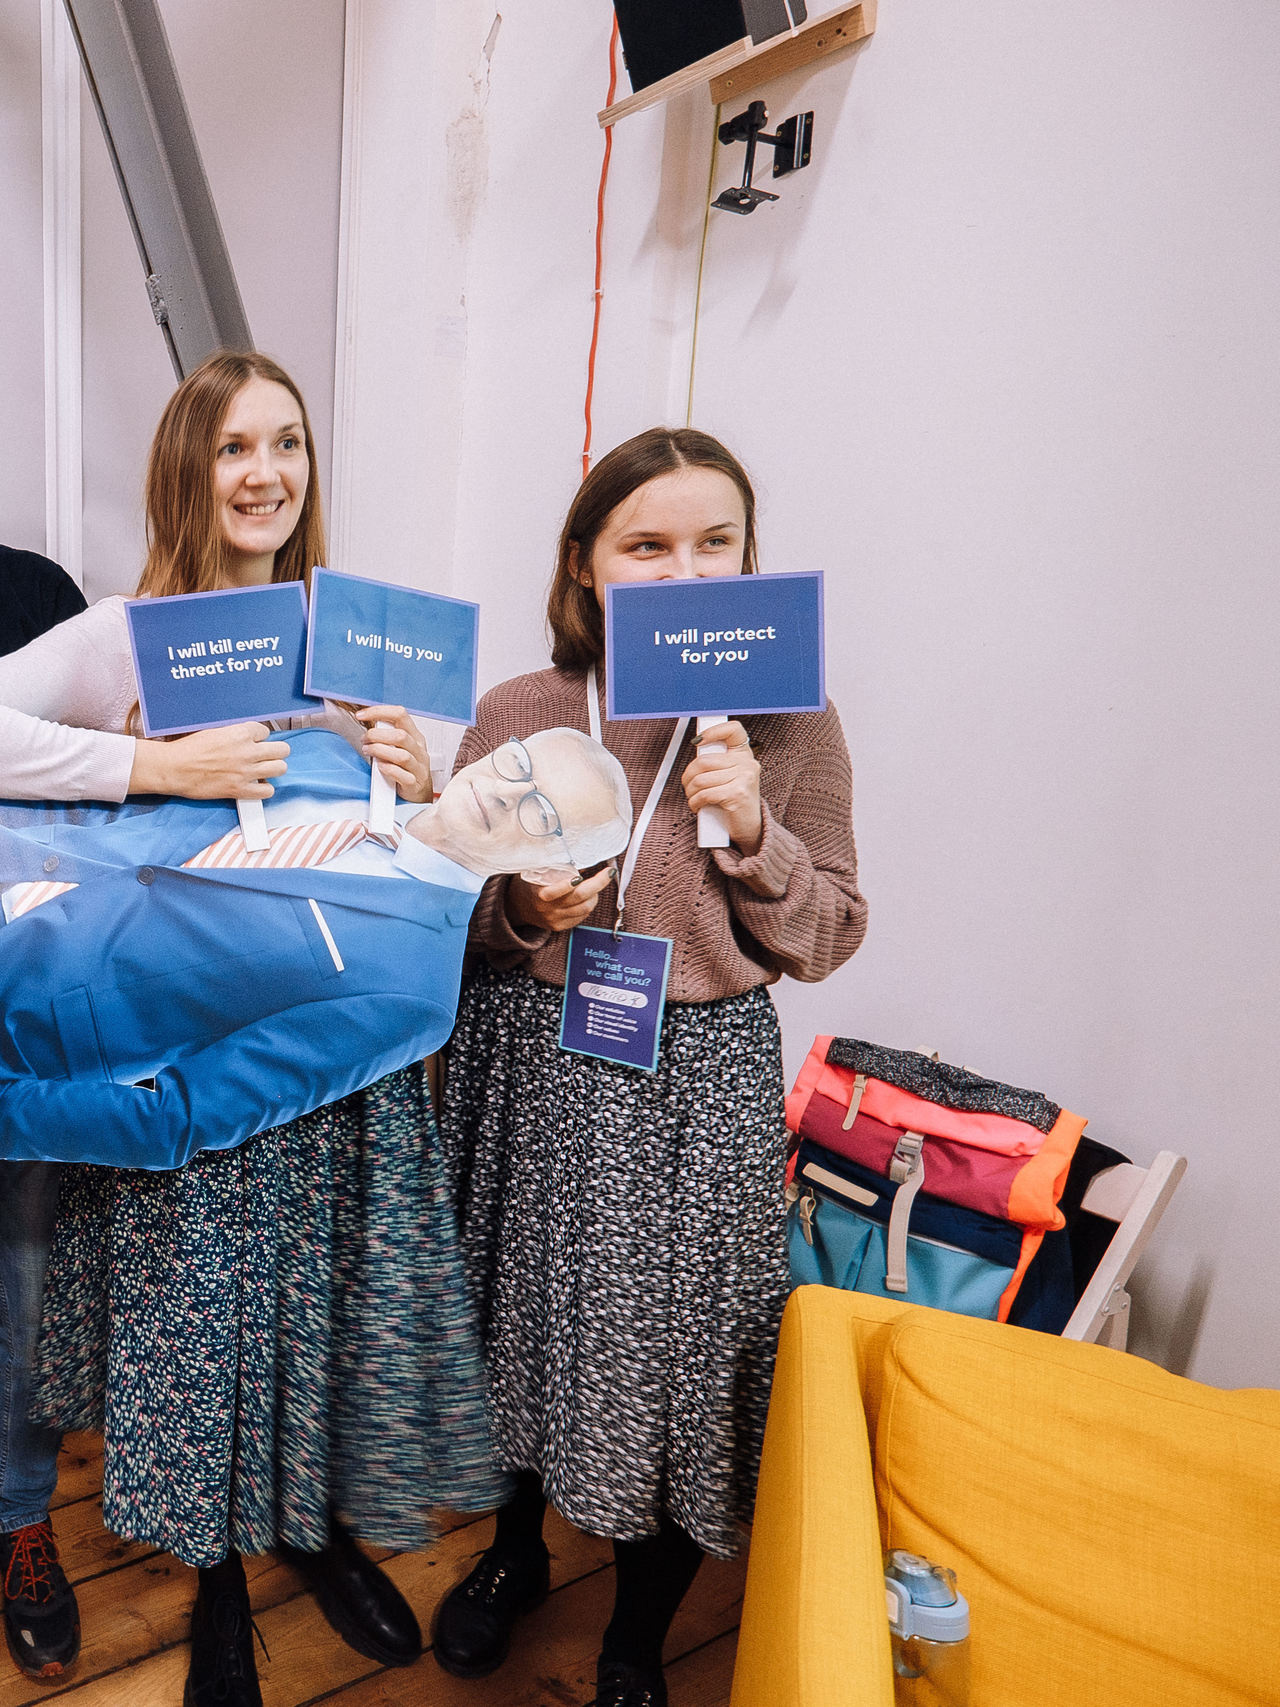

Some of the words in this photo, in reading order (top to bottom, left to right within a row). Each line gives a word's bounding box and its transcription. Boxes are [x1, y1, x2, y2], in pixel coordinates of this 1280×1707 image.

[346, 628, 352, 643] I
[354, 633, 382, 650] will
[385, 637, 413, 659] hug
[415, 647, 443, 663] you
[654, 630, 660, 646] I
[664, 628, 698, 645] will
[703, 625, 777, 647] protect
[167, 646, 175, 661] I
[176, 642, 207, 659] will
[208, 638, 233, 655] kill
[235, 636, 280, 652] every
[680, 648, 710, 664] for
[713, 649, 749, 666] you
[170, 660, 226, 680] threat
[225, 657, 252, 673] for
[253, 655, 284, 673] you
[586, 968, 602, 977] we
[603, 971, 623, 982] call
[624, 975, 651, 987] you?
[595, 961, 622, 972] what
[623, 965, 645, 976] can
